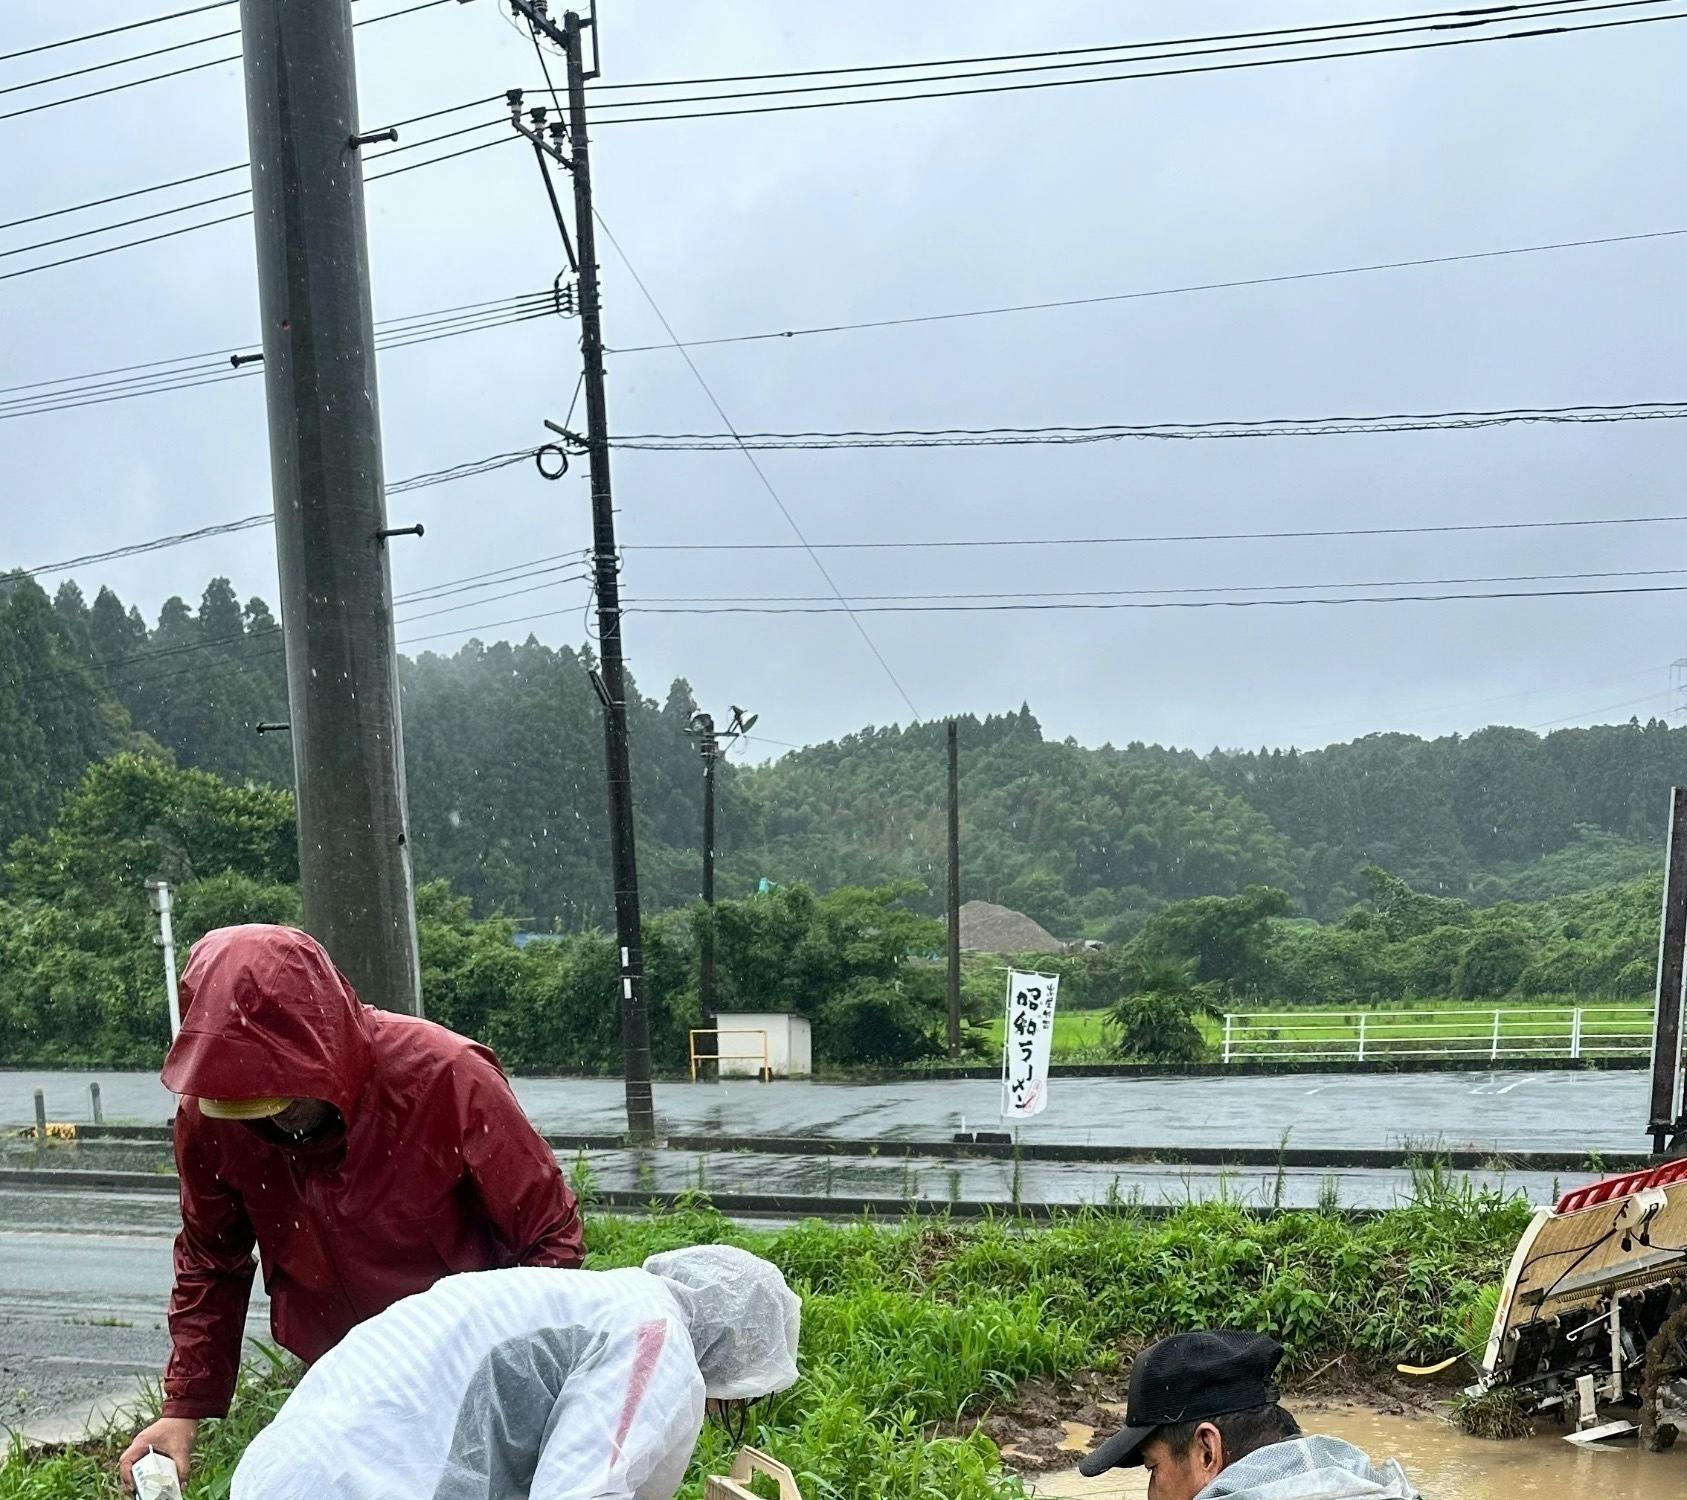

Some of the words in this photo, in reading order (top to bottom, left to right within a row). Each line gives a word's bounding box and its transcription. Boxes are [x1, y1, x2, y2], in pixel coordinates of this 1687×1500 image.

[1012, 987, 1042, 1109] 昭和ラーメン
